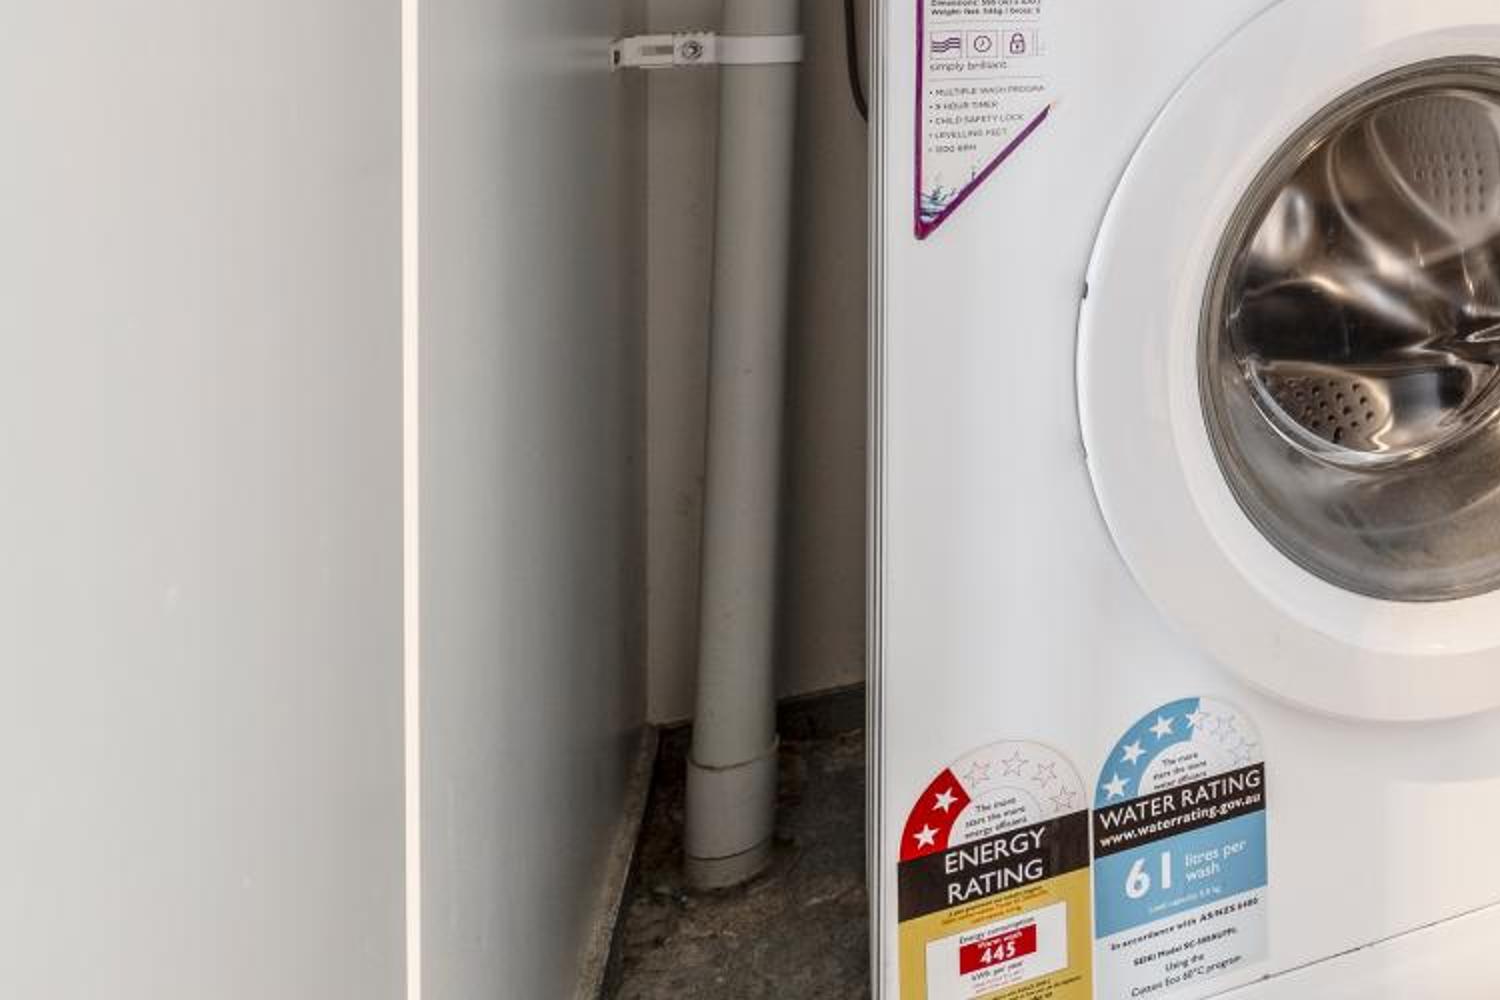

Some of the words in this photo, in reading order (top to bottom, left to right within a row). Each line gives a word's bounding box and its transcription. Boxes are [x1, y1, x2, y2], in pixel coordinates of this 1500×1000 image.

[929, 61, 965, 73] simply
[1099, 796, 1176, 831] WATER
[1180, 769, 1261, 807] RATING
[1099, 793, 1261, 848] www.waterrating.gov.au
[945, 826, 1046, 875] ENERGY
[1185, 847, 1219, 867] litres
[1223, 839, 1247, 859] per
[948, 858, 1044, 905] RATING
[1185, 862, 1220, 882] wash
[960, 932, 985, 945] Energy
[980, 940, 1017, 964] 445
